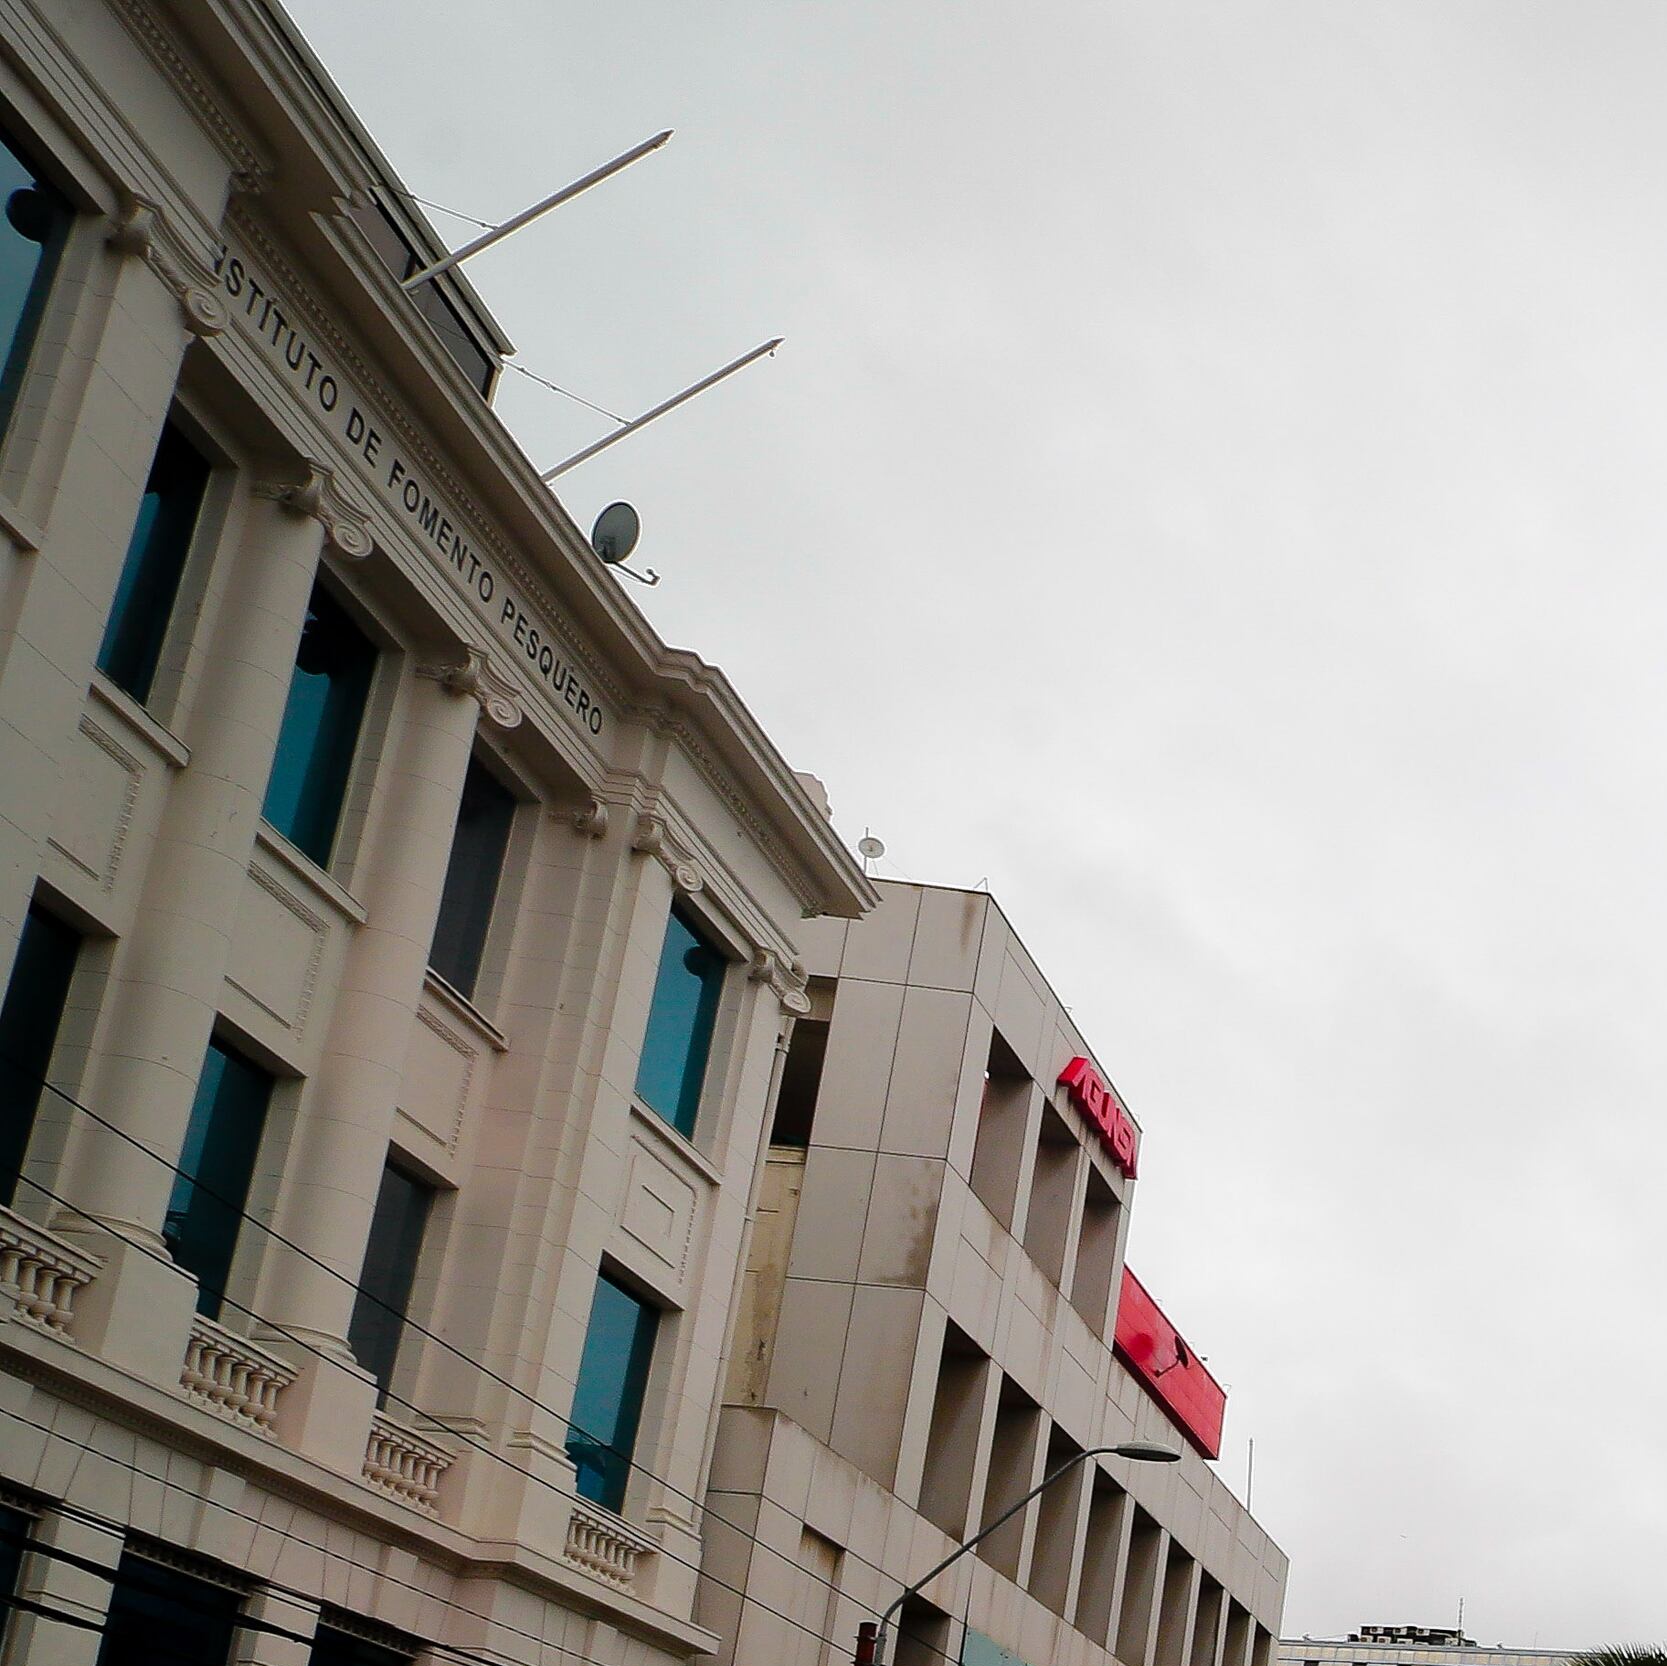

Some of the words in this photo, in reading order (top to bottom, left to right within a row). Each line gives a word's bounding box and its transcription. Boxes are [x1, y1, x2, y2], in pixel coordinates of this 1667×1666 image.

[346, 410, 383, 469] DE
[388, 458, 496, 604] FOMENTO
[501, 596, 604, 736] PESQUERO
